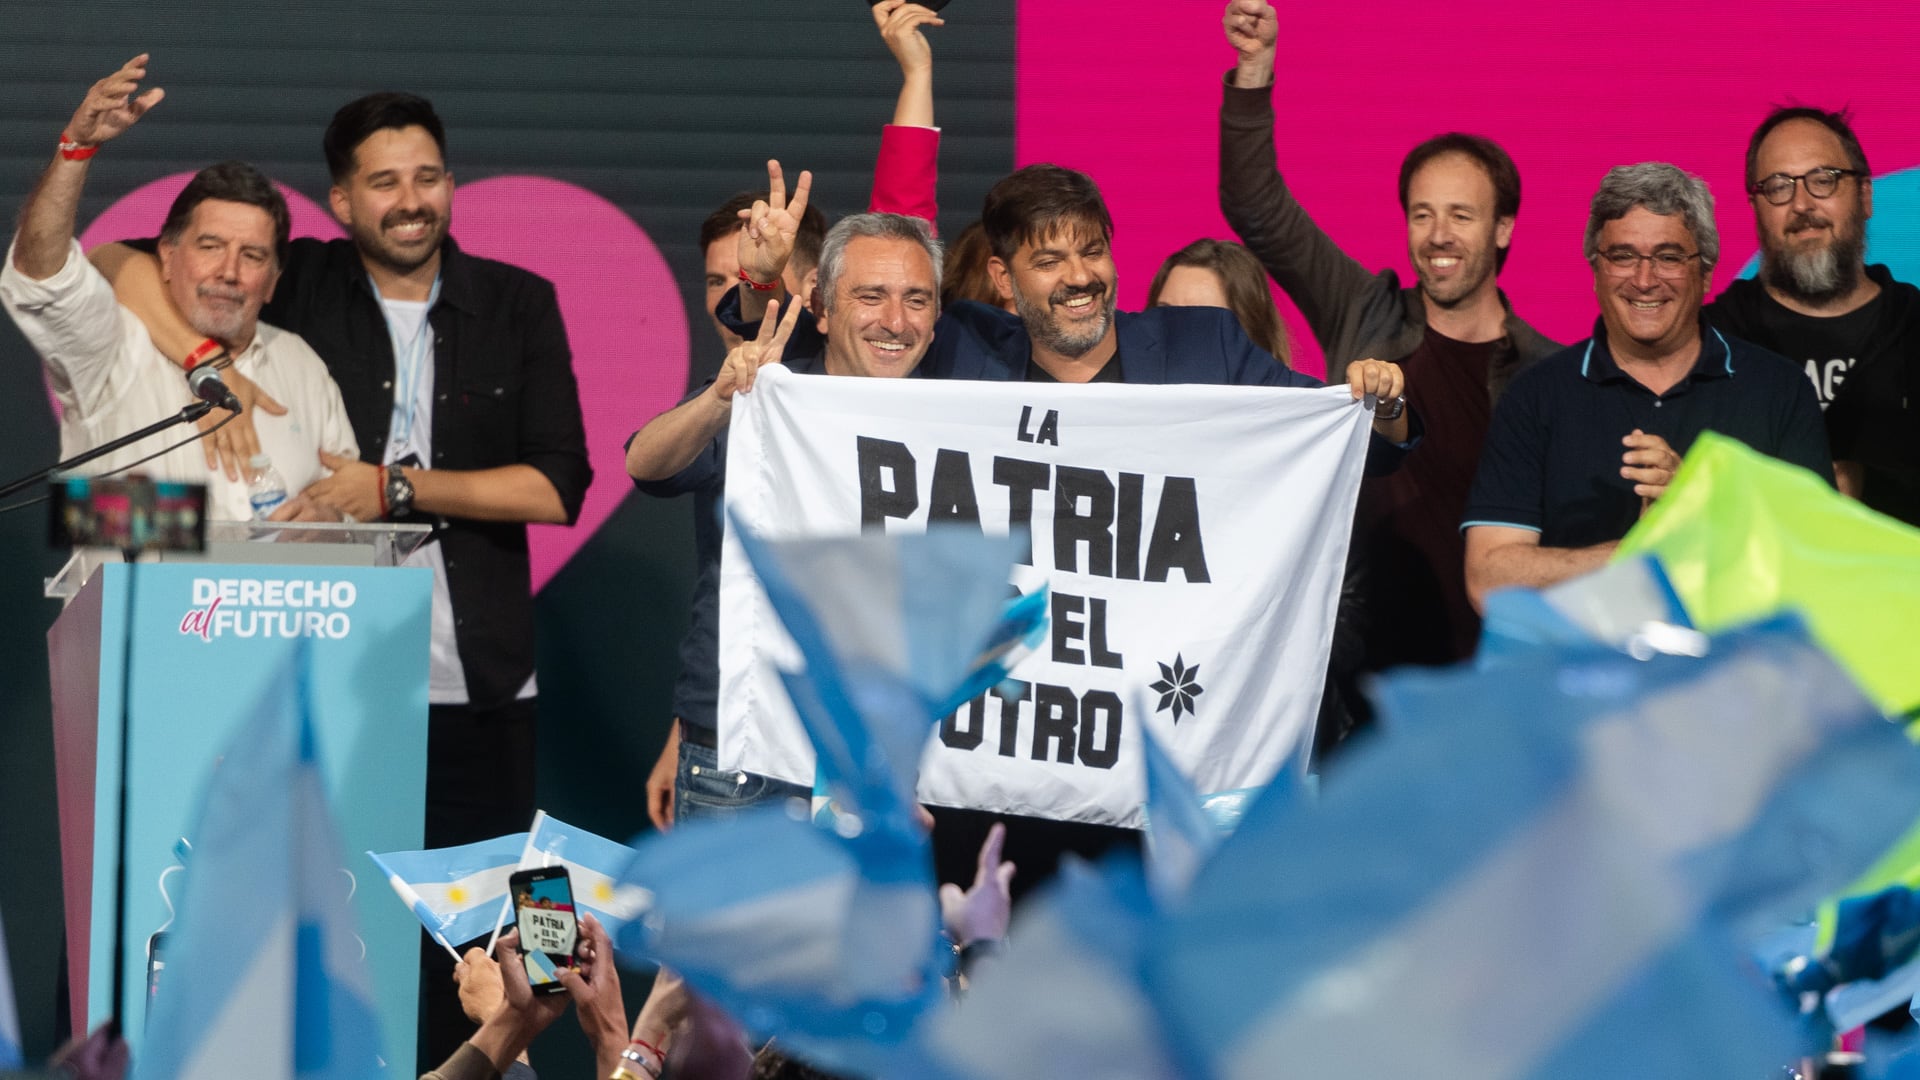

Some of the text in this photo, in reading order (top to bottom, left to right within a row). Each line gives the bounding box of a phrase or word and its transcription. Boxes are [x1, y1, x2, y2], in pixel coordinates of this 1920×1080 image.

[1017, 405, 1058, 447] LA
[856, 435, 1211, 584] PATRIA
[192, 578, 357, 608] DERECHO
[179, 597, 350, 642] al FUTURO
[1051, 591, 1123, 669] EL
[939, 677, 1123, 769] OTRO
[533, 915, 565, 930] PATRIA
